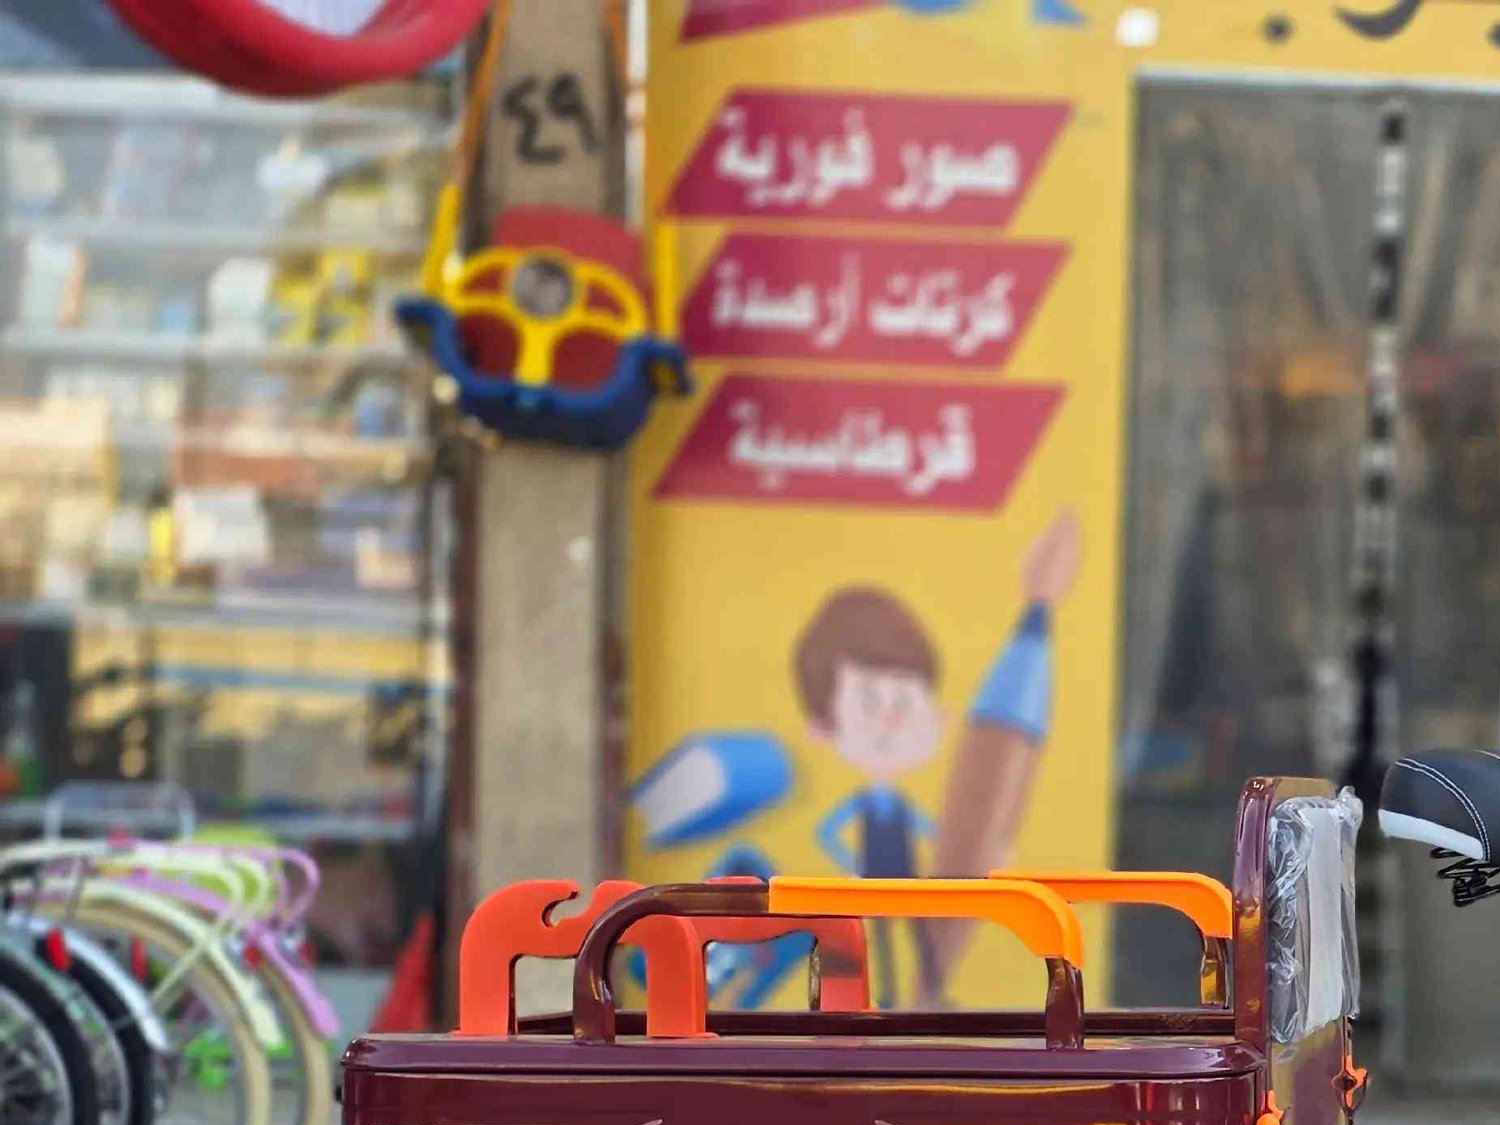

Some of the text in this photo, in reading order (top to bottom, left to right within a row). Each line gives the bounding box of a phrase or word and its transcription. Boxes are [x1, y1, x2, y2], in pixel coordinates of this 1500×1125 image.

[715, 107, 1020, 209] صور فورية
[728, 400, 977, 495] قرطاسية
